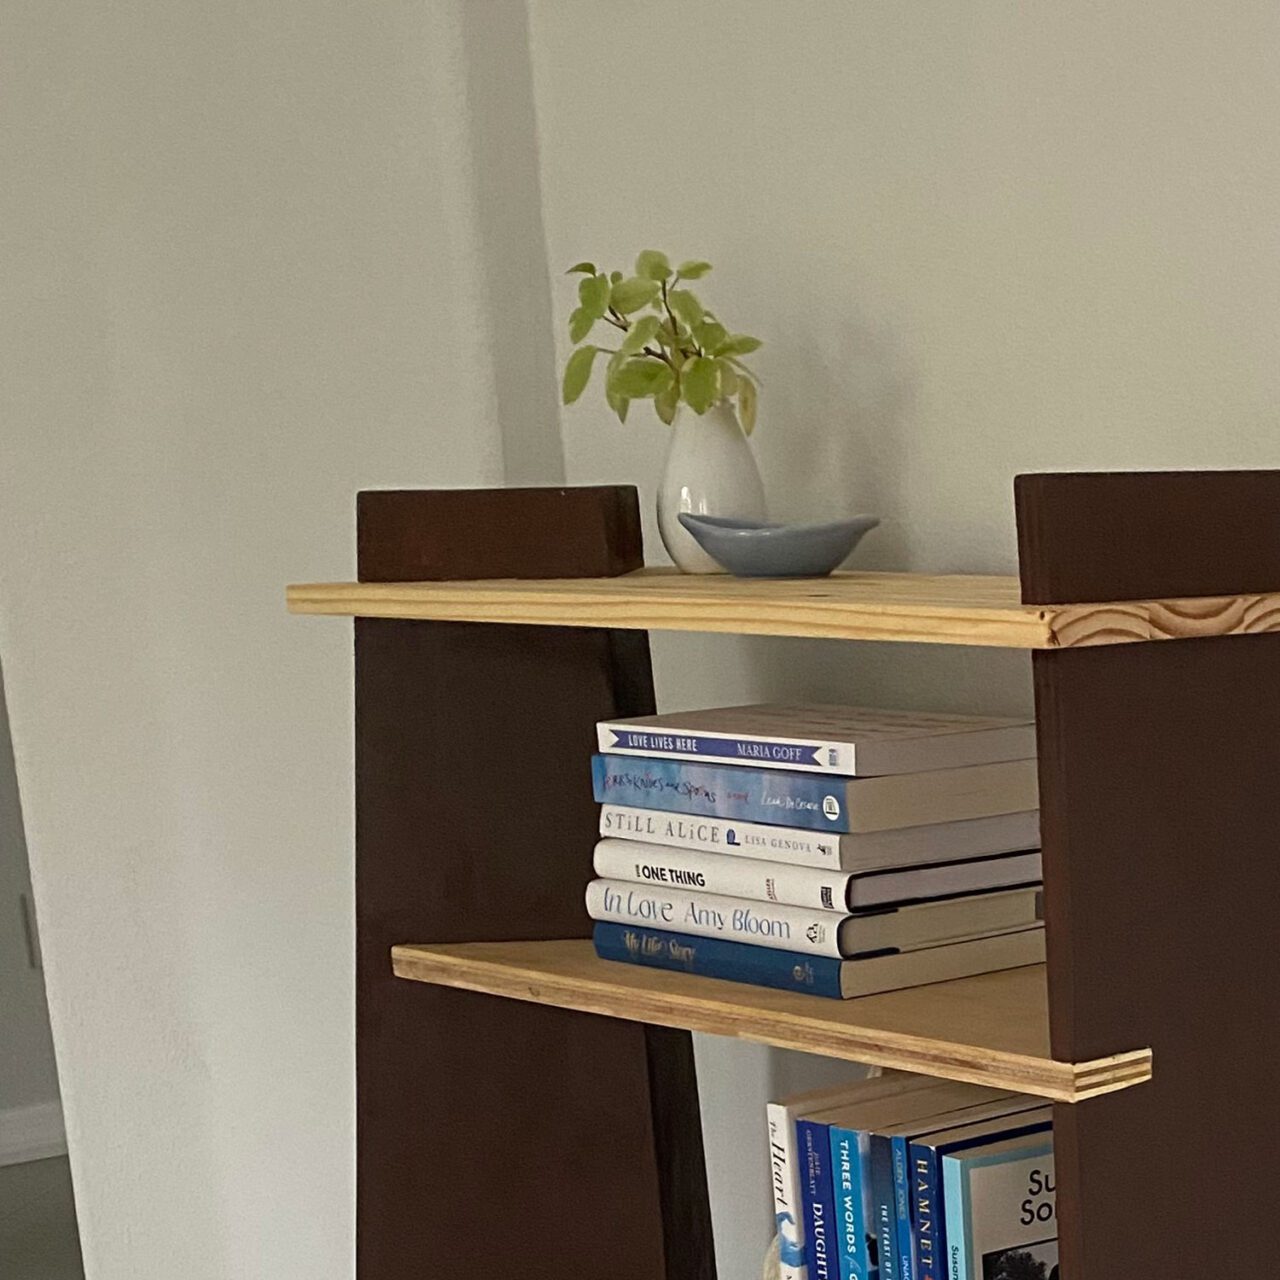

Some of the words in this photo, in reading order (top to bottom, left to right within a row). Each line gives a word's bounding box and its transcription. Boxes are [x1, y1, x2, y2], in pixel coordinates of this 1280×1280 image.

[628, 734, 648, 748] LOVE
[650, 737, 674, 750] LIVES
[676, 738, 699, 752] HERE
[737, 743, 770, 758] MARIA
[772, 747, 802, 760] GOFF
[745, 835, 767, 846] LISA
[771, 839, 812, 853] GENOVA
[642, 865, 668, 881] ONE
[668, 869, 706, 887] THING
[604, 887, 622, 914] In
[627, 891, 674, 922] Love
[684, 901, 727, 930] Amy
[732, 908, 790, 939] Bloom
[771, 1142, 788, 1206] Heart
[840, 1140, 852, 1191] THREE
[843, 1196, 857, 1254] WORDS
[917, 1160, 933, 1269] HAMNET
[1021, 1199, 1053, 1226] So
[882, 1227, 891, 1257] FEAST
[884, 1261, 892, 1274] OF
[951, 1246, 960, 1280] Susan
